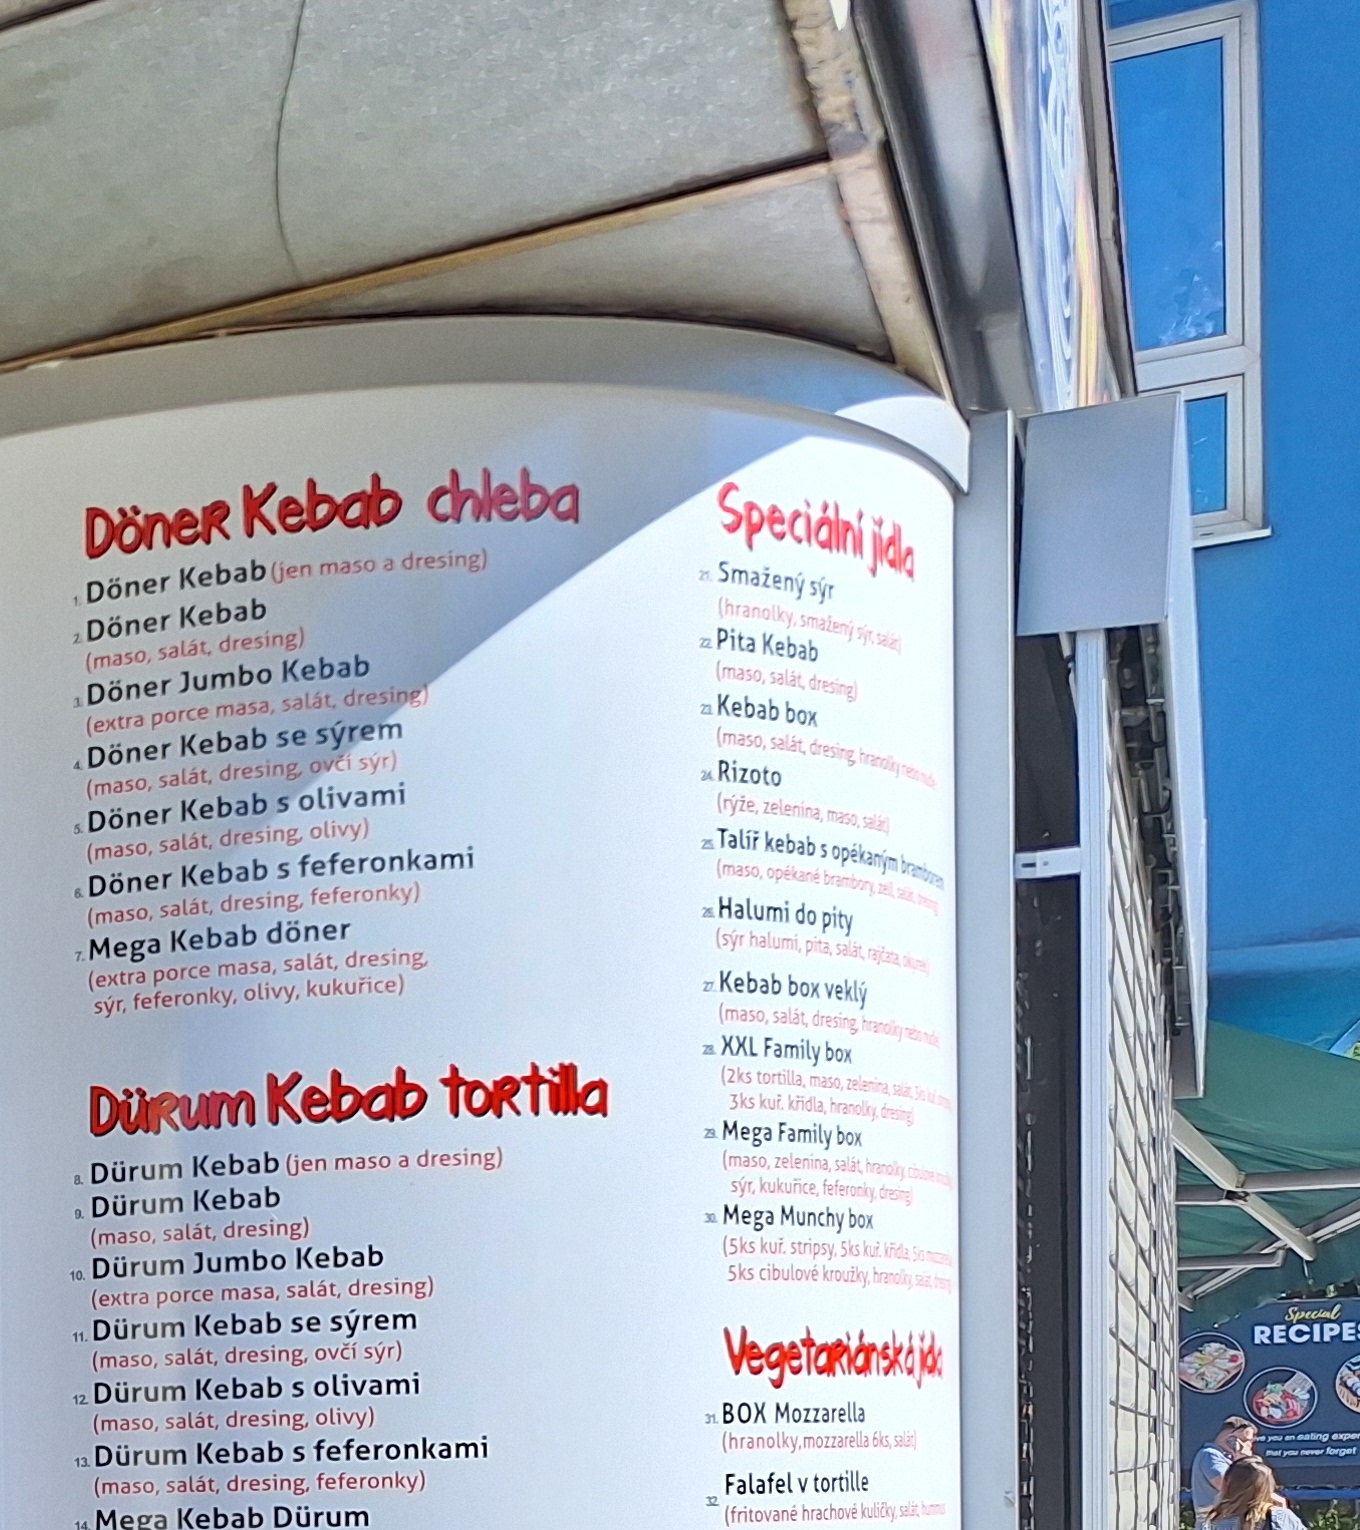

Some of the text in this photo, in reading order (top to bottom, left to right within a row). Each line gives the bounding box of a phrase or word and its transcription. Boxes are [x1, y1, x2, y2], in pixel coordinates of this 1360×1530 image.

[242, 474, 402, 538] Kebab
[428, 470, 578, 522] chleba
[86, 574, 172, 605] Döner
[178, 558, 266, 591] Kebab
[318, 558, 378, 576] maso
[382, 557, 396, 572] a
[717, 560, 834, 605] Smažený sýr
[716, 626, 818, 663] Pita Kebab
[86, 653, 370, 707] Döner Jumbo Kebab
[87, 715, 403, 769] Döner Kebab se sýrem
[717, 758, 782, 787] Rizoto
[88, 844, 474, 898] Döner Kebab s feferonkami
[718, 895, 853, 938] Halumi do pity
[88, 919, 352, 964] Mega Kebab döner
[718, 969, 782, 996] Kebab
[787, 973, 820, 999] box
[267, 1066, 427, 1125] Kebab
[722, 1203, 874, 1235] Mega Munchy box
[92, 1243, 384, 1280] Dürum Jumbo Kebab
[1285, 1304, 1342, 1323] Special
[1254, 1322, 1360, 1344] RECIPE
[722, 1400, 866, 1425] BOX Mozzarella
[94, 1434, 488, 1467] Dürum Kebab s feferonkami
[1326, 1446, 1357, 1456] forget
[724, 1469, 869, 1496] Falafel v tortille
[176, 1505, 264, 1530] Kebab
[273, 1504, 369, 1529] Dürum
